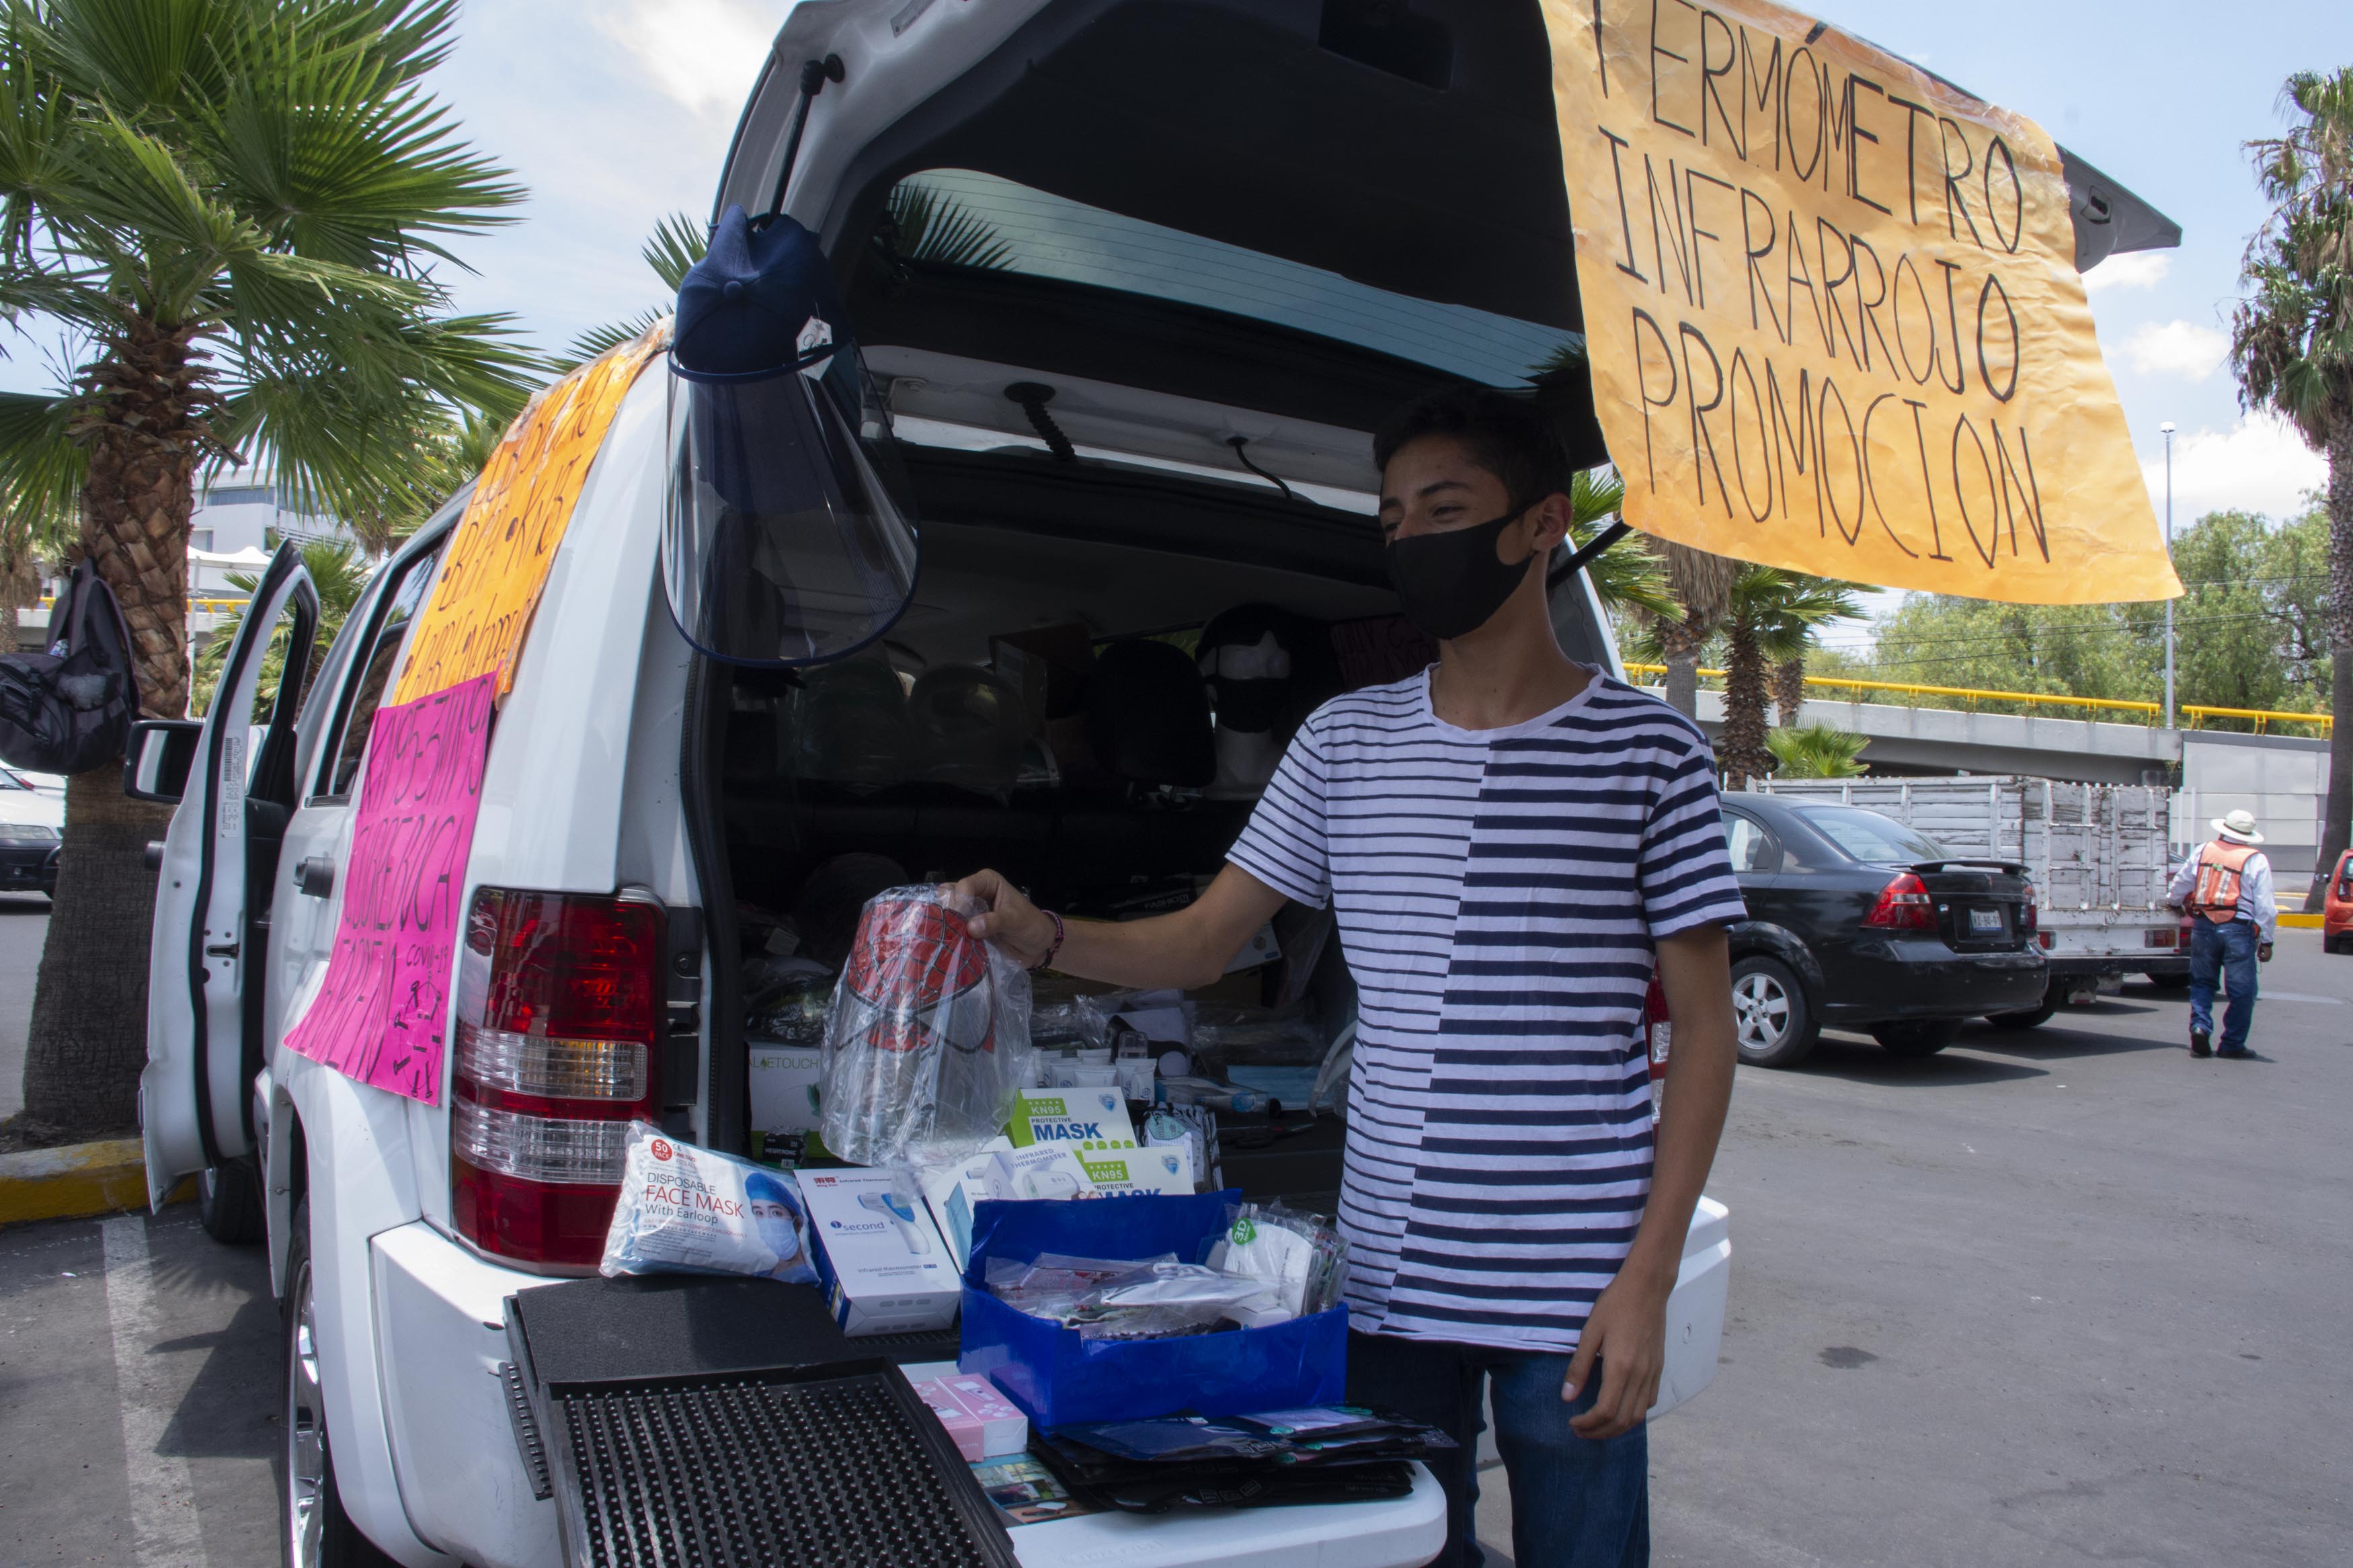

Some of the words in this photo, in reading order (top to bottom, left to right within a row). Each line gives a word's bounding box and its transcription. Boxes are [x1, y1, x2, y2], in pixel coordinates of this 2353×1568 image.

[1598, 126, 2019, 404] INFRARROJO
[1632, 307, 2050, 569] PROMOCION
[406, 943, 449, 974] COVID-19
[1031, 1106, 1062, 1115] KN95
[1033, 1122, 1103, 1141] MASK
[654, 1151, 670, 1159] PACK
[655, 1141, 668, 1153] 50
[1016, 1148, 1054, 1161] INFRARED
[1011, 1152, 1068, 1169] THERMOMETER
[647, 1172, 716, 1195] DISPOSABLE
[1092, 1170, 1123, 1180] KN95
[645, 1185, 690, 1206] FACE
[696, 1193, 745, 1219] MASK
[645, 1204, 673, 1216] With
[677, 1207, 718, 1225] Earloop
[658, 1219, 686, 1227] BRATHING
[843, 1221, 885, 1231] second
[1234, 1220, 1247, 1241] 3D
